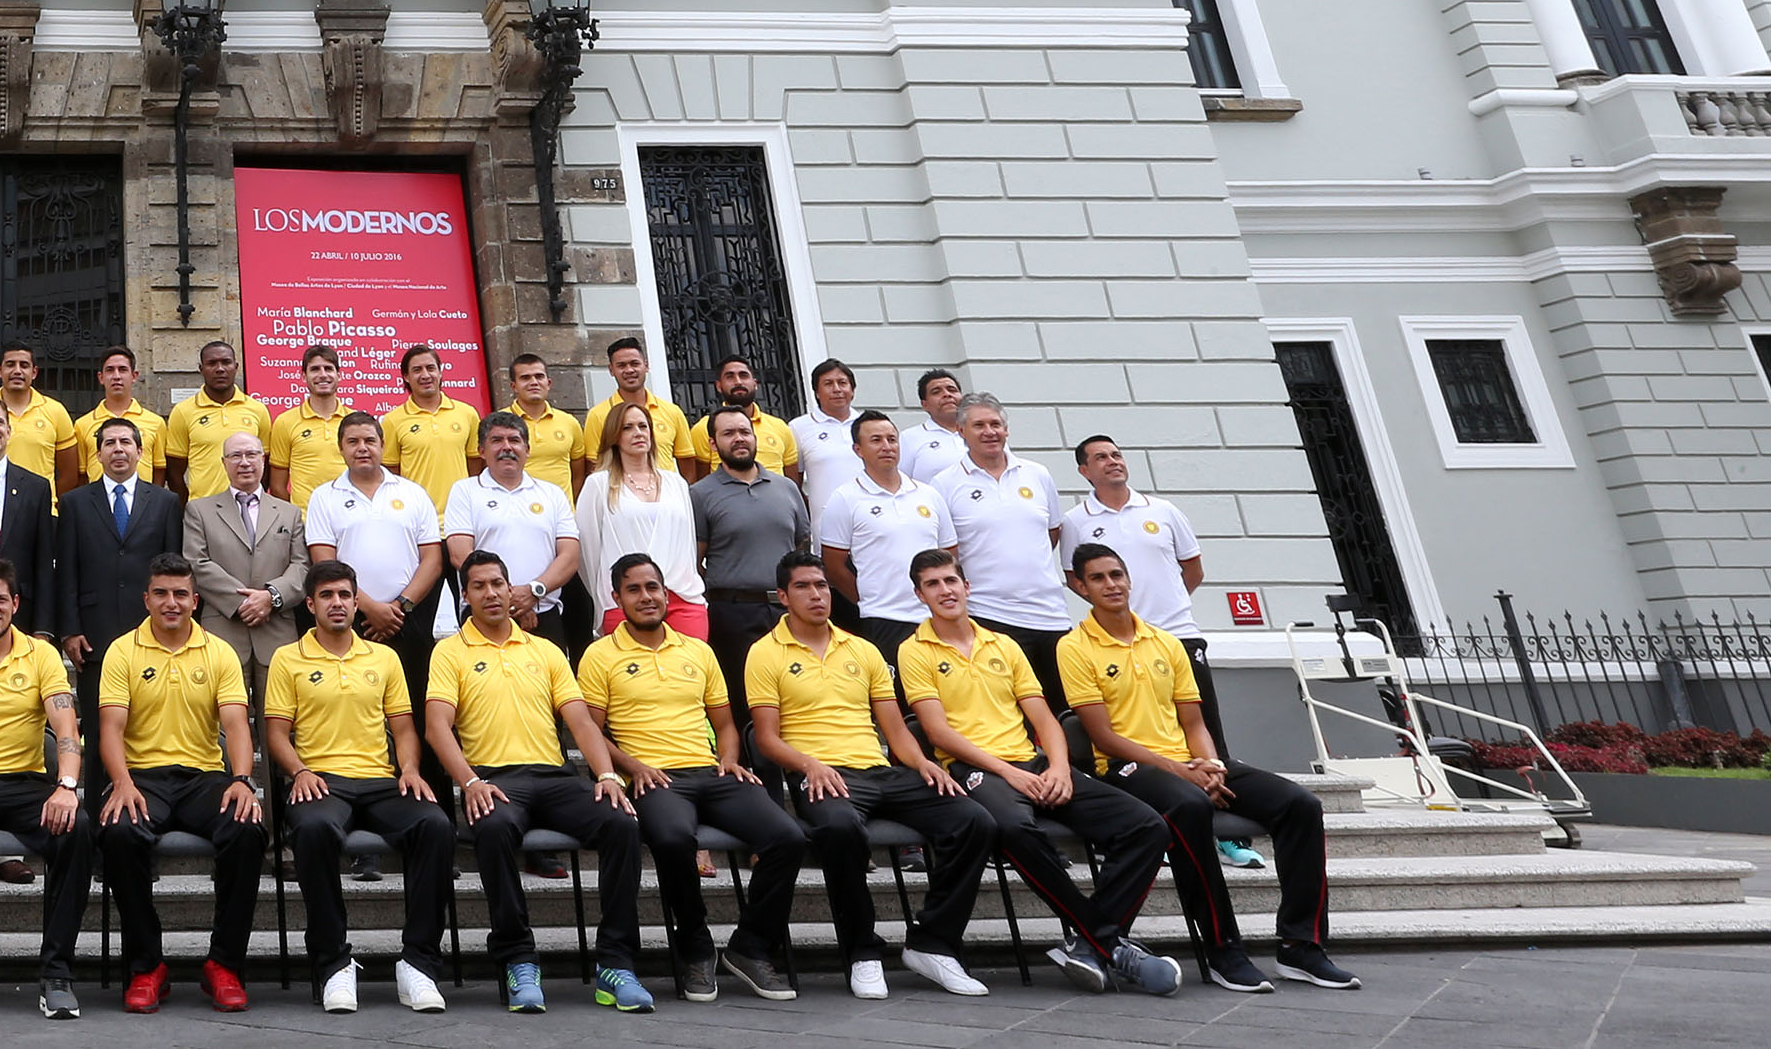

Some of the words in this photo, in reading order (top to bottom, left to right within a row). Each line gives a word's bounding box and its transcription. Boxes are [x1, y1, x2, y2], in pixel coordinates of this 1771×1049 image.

[594, 179, 616, 188] 975
[253, 208, 453, 236] LOSMODERNOS
[311, 251, 321, 260] 22
[321, 251, 343, 260] ABRIL
[350, 252, 359, 261] 10
[360, 252, 382, 262] JULIO
[384, 252, 402, 261] 2016
[257, 307, 291, 318] María
[294, 307, 353, 318] Blanchard
[372, 309, 409, 318] Germán
[410, 311, 416, 320] y
[418, 310, 437, 319] Lola
[439, 310, 468, 319] Cueto
[273, 319, 324, 336] Pablo
[328, 321, 397, 337] Picasso
[257, 334, 304, 348] George
[308, 335, 352, 349] Braque
[427, 340, 478, 352] Soulages
[361, 348, 396, 360] Léger
[278, 370, 300, 379] José
[354, 371, 391, 380] Orozco
[441, 377, 475, 387] nnard
[291, 384, 310, 393] Dav
[356, 384, 404, 396] Siqueiros
